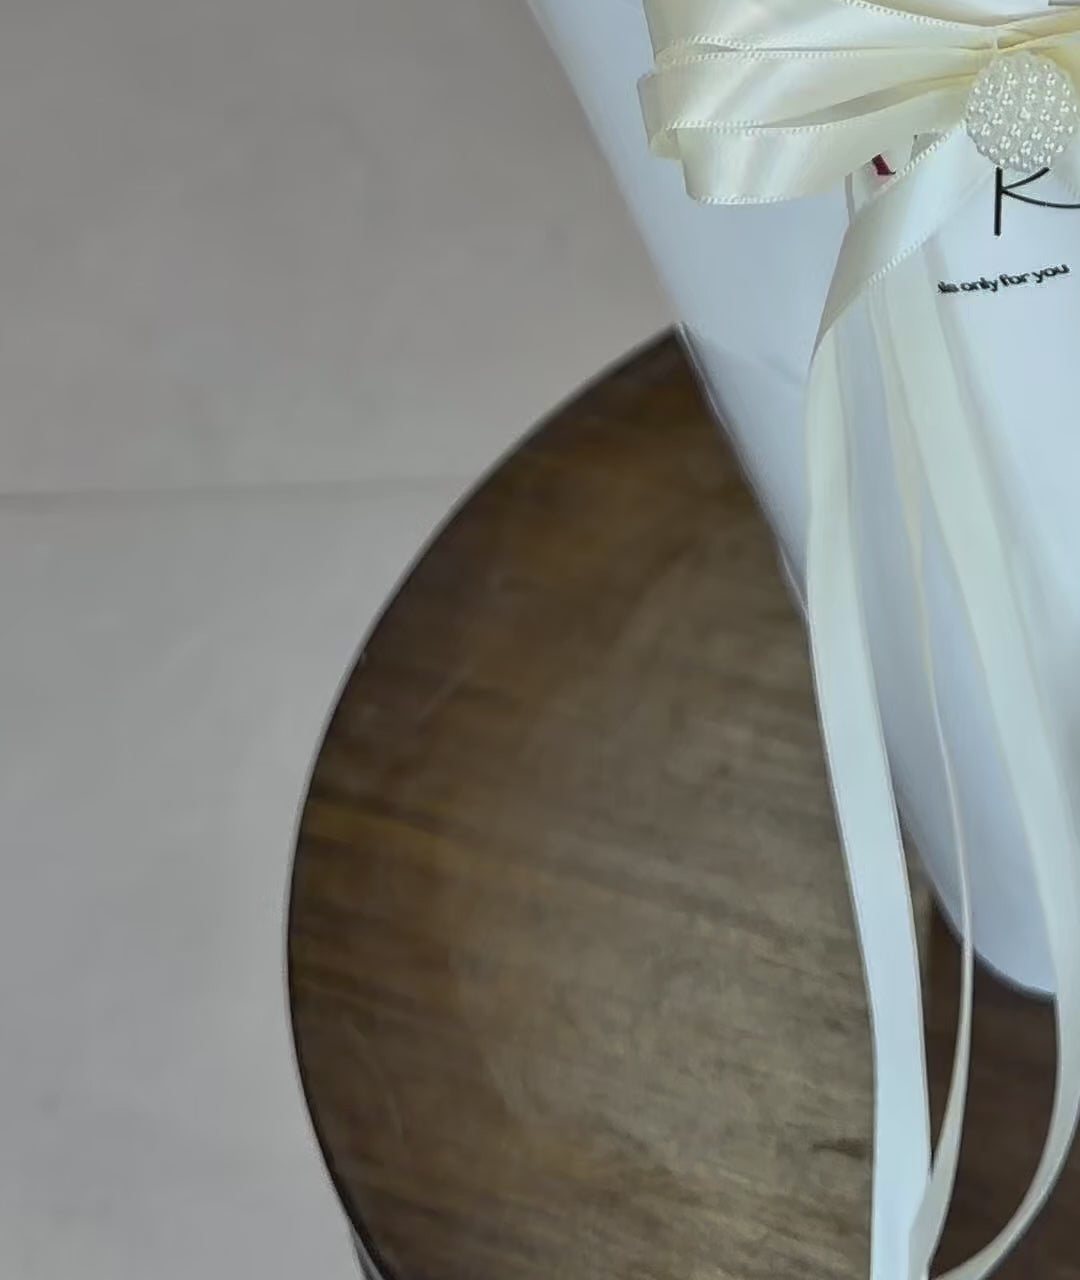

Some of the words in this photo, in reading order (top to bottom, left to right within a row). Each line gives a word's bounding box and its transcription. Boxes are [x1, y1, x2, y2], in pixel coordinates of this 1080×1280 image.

[960, 277, 998, 292] only
[999, 273, 1030, 287] for
[1031, 263, 1070, 283] you
